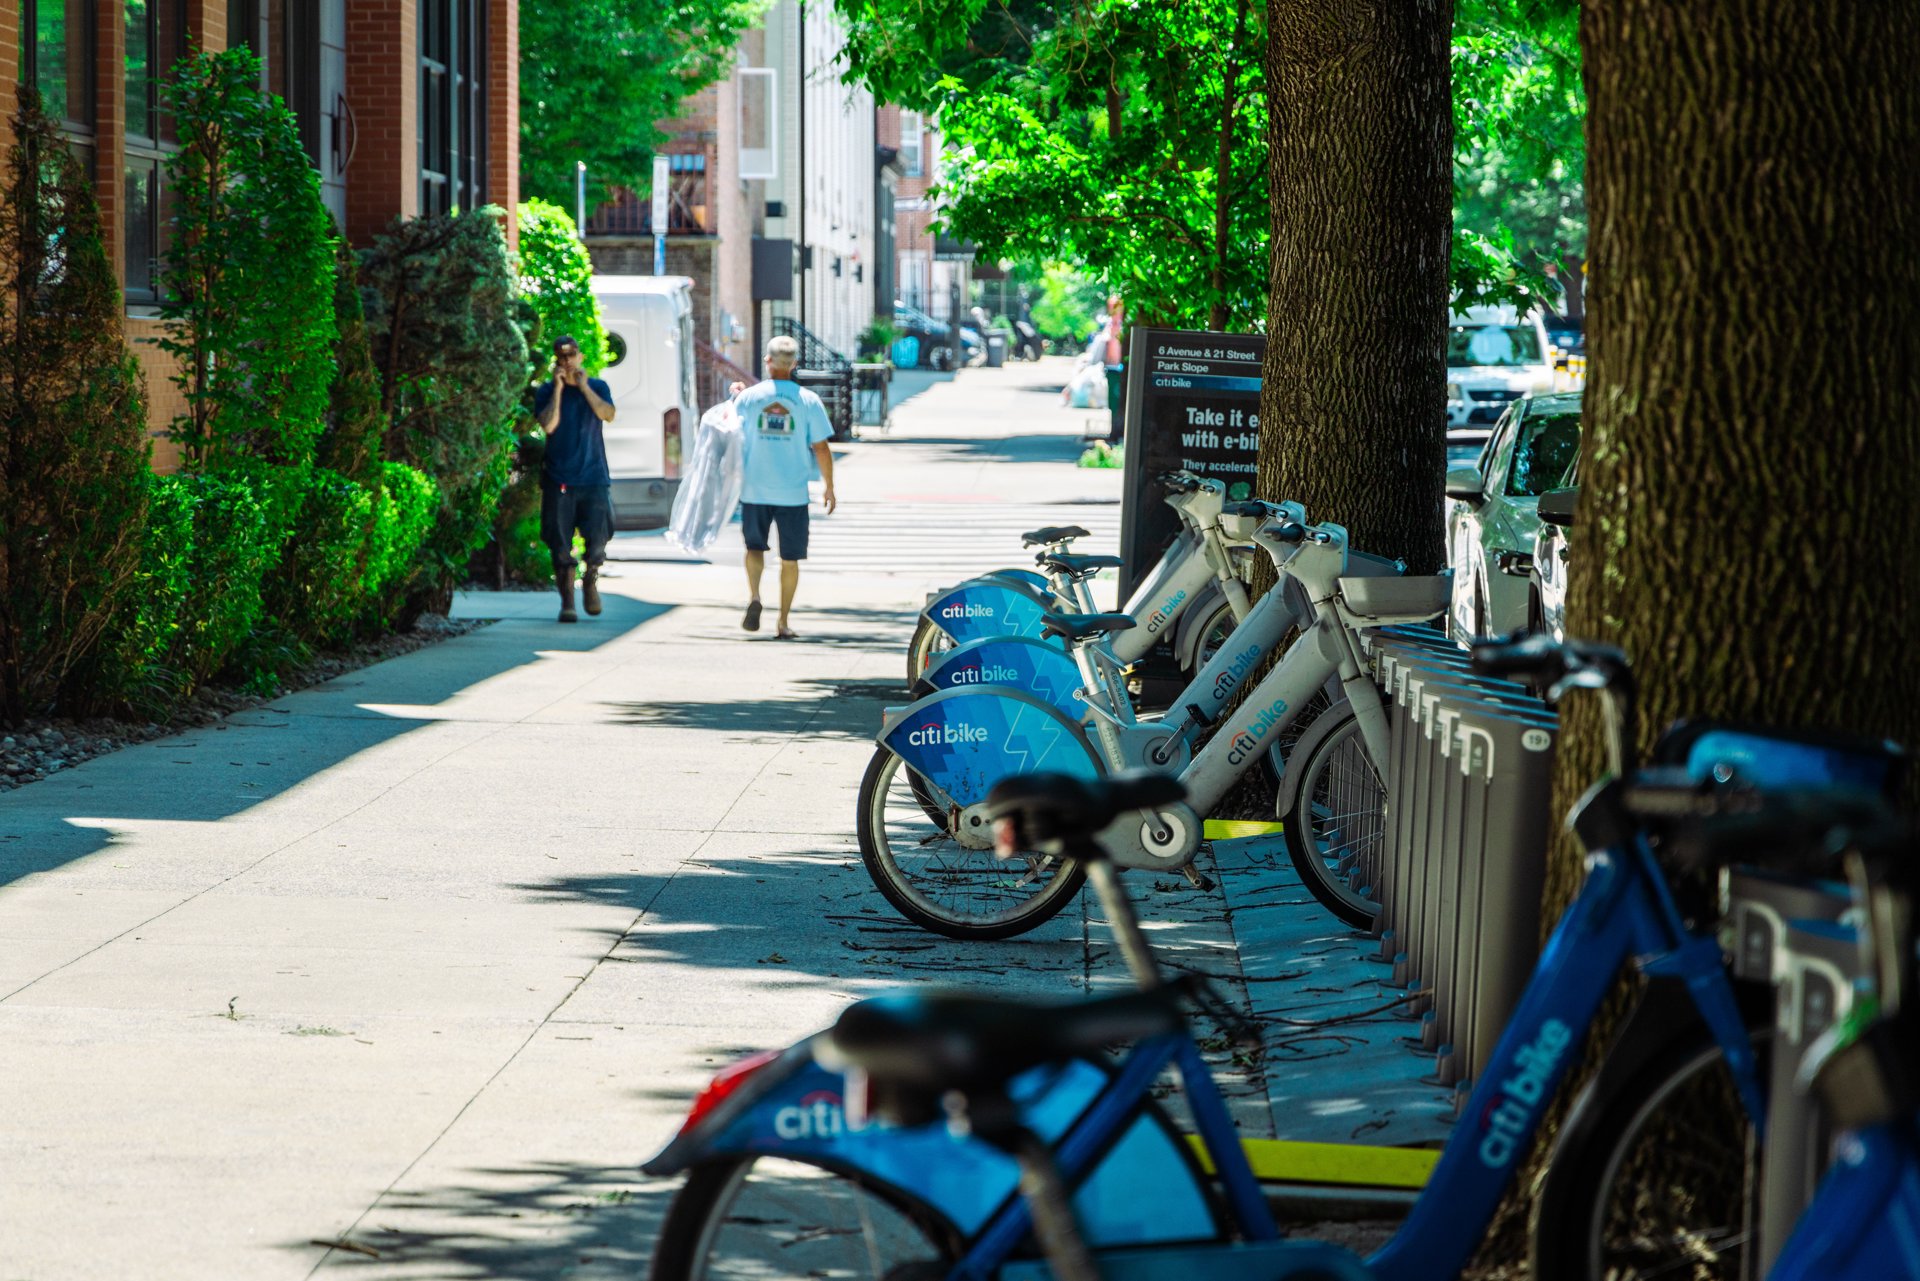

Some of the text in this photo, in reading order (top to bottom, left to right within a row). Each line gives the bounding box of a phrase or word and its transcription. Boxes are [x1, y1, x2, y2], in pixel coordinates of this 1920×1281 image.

[1158, 346, 1256, 360] 6 Avenue & 21 Street
[1157, 361, 1209, 374] Park Slope
[1186, 407, 1225, 426] Take
[1229, 408, 1243, 427] it
[1181, 429, 1219, 448] with
[1182, 458, 1206, 473] They
[981, 665, 1018, 682] bike
[1247, 698, 1288, 739] bike
[908, 722, 988, 746] citi bike
